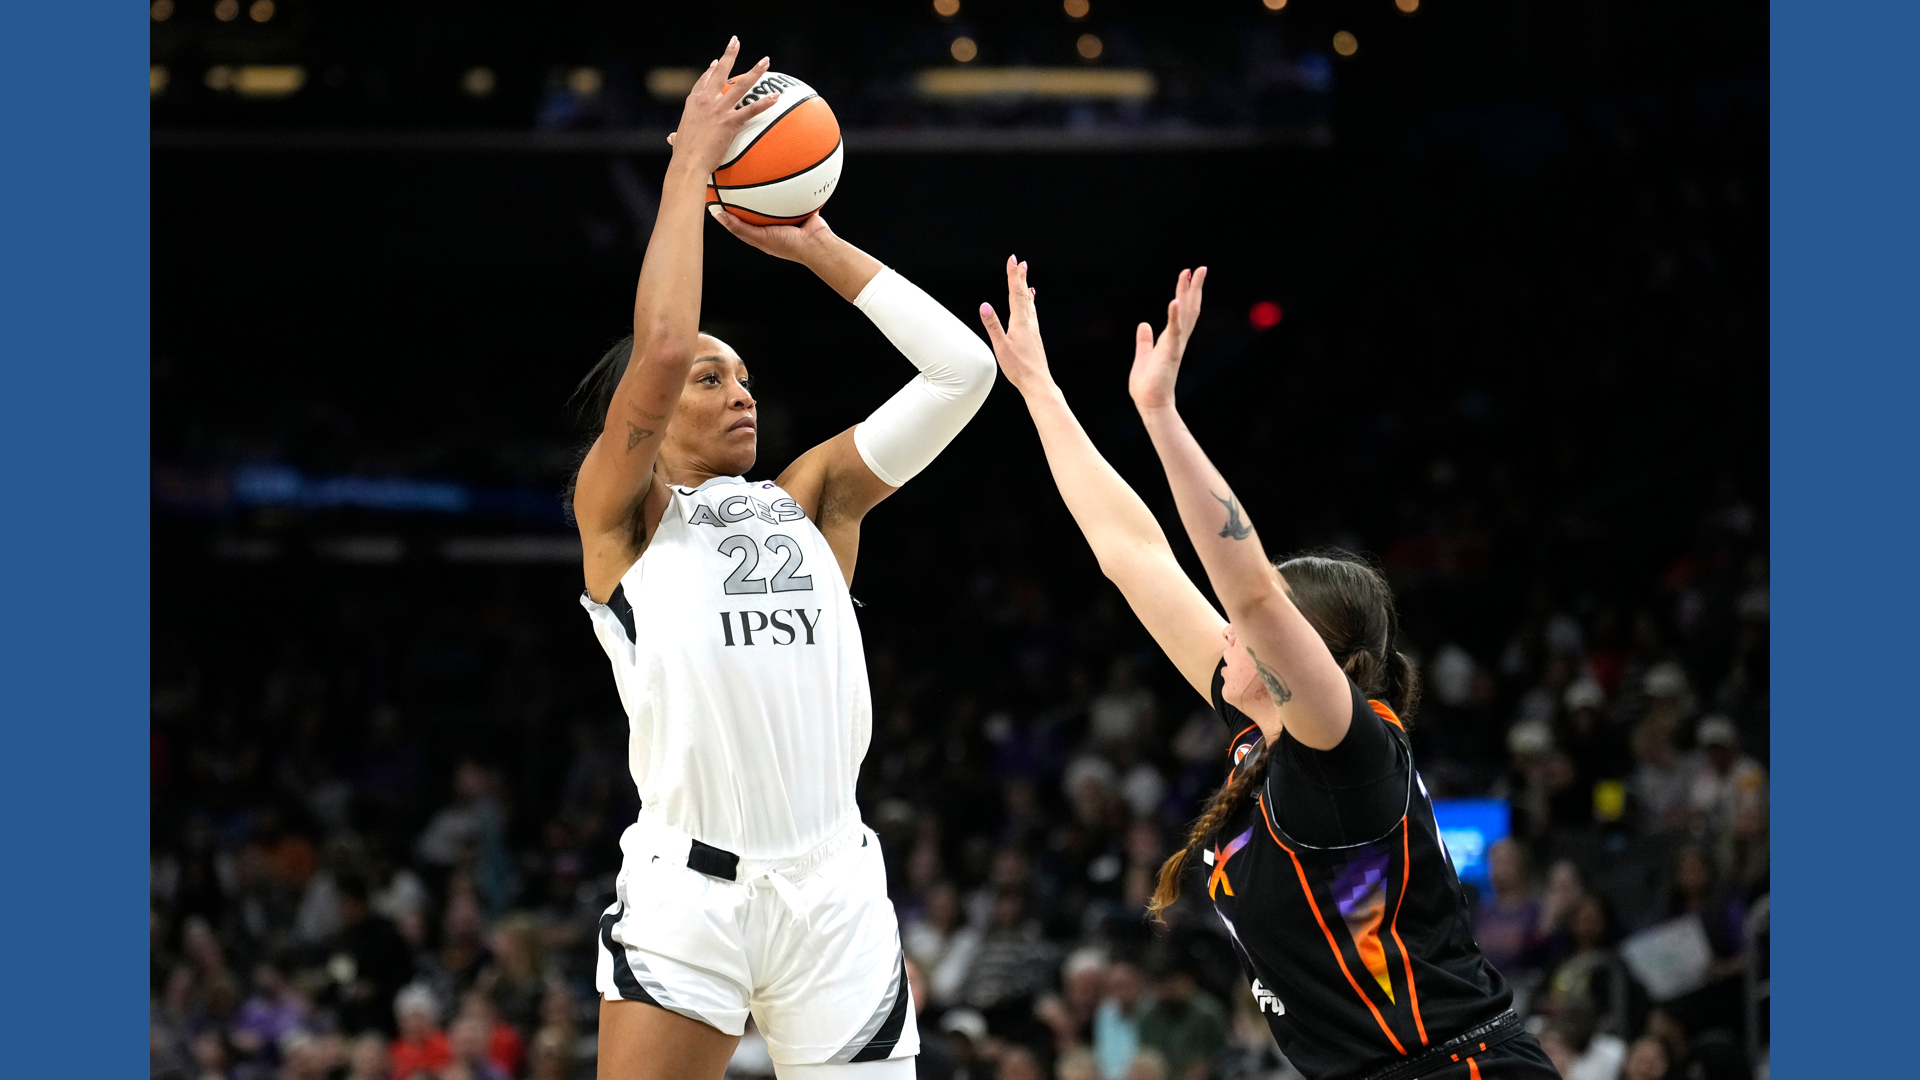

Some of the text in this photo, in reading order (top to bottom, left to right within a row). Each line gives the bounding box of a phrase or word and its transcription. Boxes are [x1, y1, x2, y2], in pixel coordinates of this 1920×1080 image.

[688, 495, 806, 528] ACES
[717, 534, 814, 595] 22
[719, 608, 822, 647] IPSY
